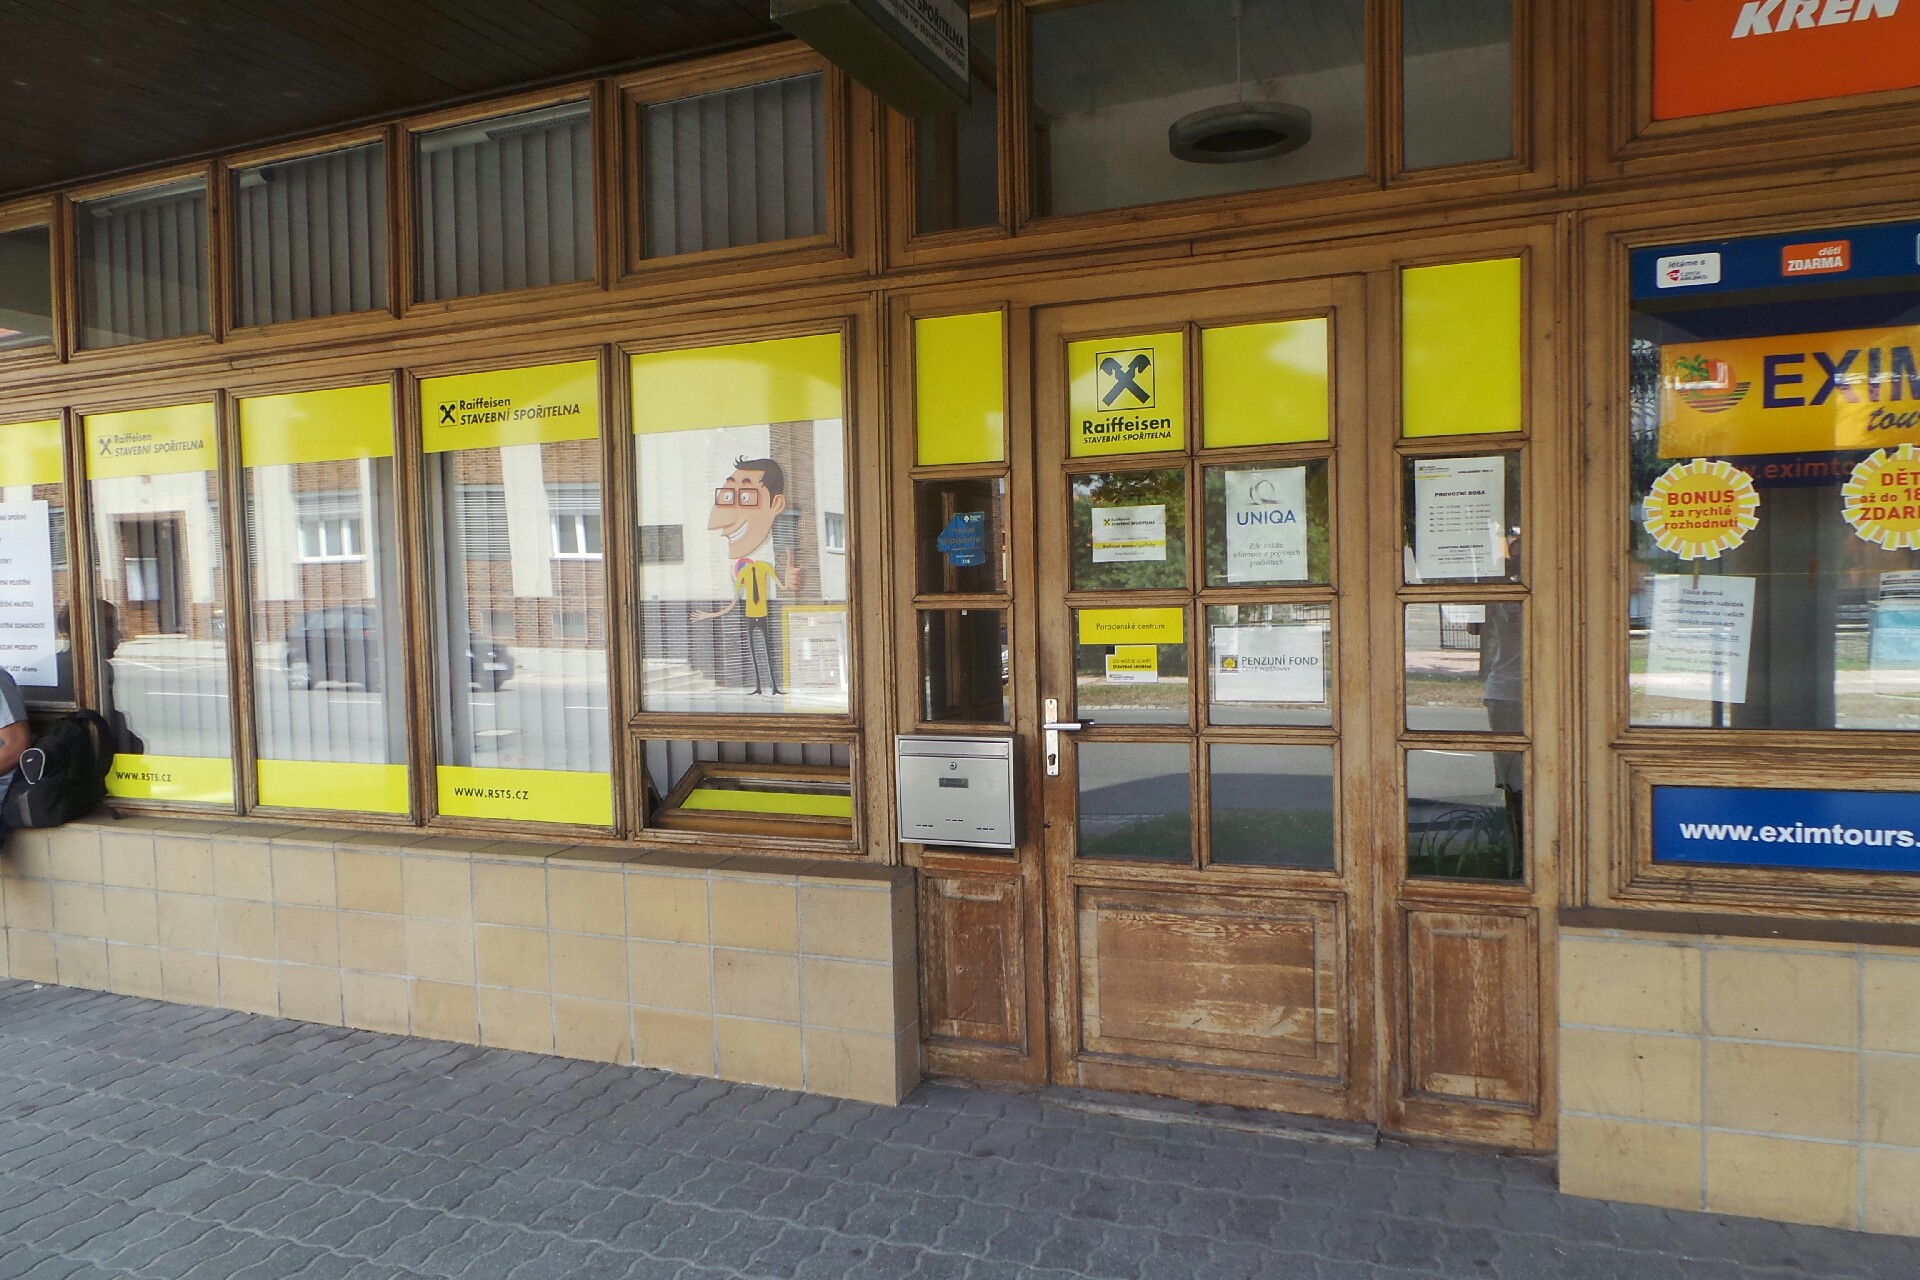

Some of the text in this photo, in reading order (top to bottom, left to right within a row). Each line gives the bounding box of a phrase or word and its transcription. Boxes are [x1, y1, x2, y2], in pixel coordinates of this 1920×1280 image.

[1818, 246, 1843, 256] děti
[1787, 256, 1844, 272] ZDARMA
[459, 396, 511, 411] Raiffeisen
[460, 403, 580, 426] STAVEBNÍ SPOŘITELNA
[1082, 415, 1171, 435] Raiffeisen
[113, 433, 152, 444] Raiffeisen
[1083, 431, 1172, 444] STAVEBNÍ SPOŘITELNA
[115, 439, 204, 457] STAVEBNÍ SPOŘITELNA
[1667, 489, 1735, 506] BONUS
[1860, 492, 1876, 503] až
[1880, 493, 1898, 503] do
[1236, 509, 1297, 526] UNIQA
[1669, 505, 1732, 519] za rychlé
[1859, 506, 1920, 521] ZDAR
[1664, 517, 1738, 530] rozhodnutí
[1249, 542, 1261, 550] Zde
[1233, 550, 1263, 558] informace
[1096, 622, 1136, 631] Poradenské
[1241, 655, 1318, 666] PENZIJNÍ FOND
[115, 771, 172, 782] WWW.RSTS.CZ
[454, 787, 529, 800] WWW.RSTS.CZ
